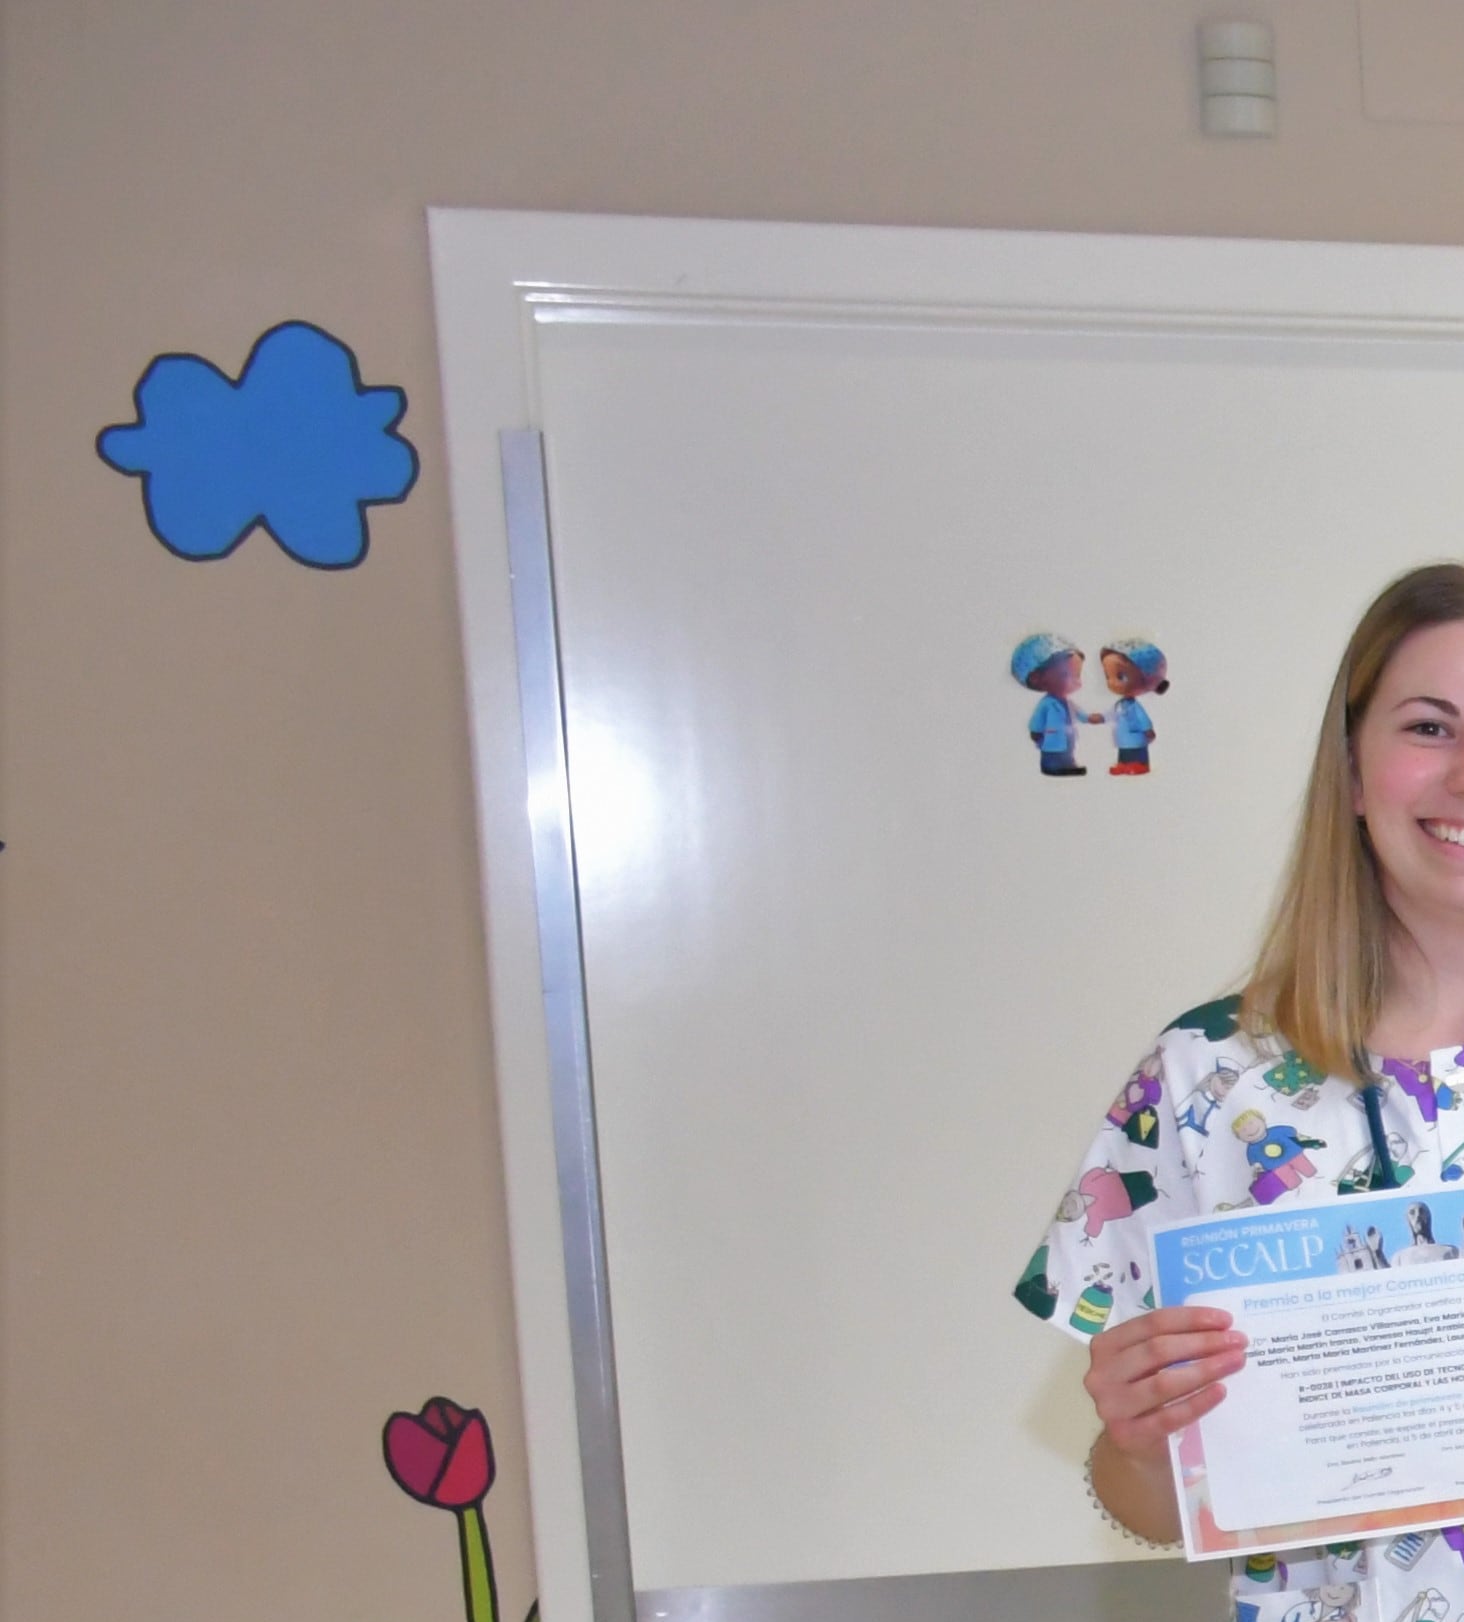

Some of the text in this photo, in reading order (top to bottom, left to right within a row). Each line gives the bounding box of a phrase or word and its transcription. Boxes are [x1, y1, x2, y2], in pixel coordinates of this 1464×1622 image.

[1180, 1233, 1326, 1285] SCCALP
[1243, 1294, 1298, 1310] Premio
[1317, 1289, 1331, 1300] la
[1336, 1281, 1381, 1300] mejor
